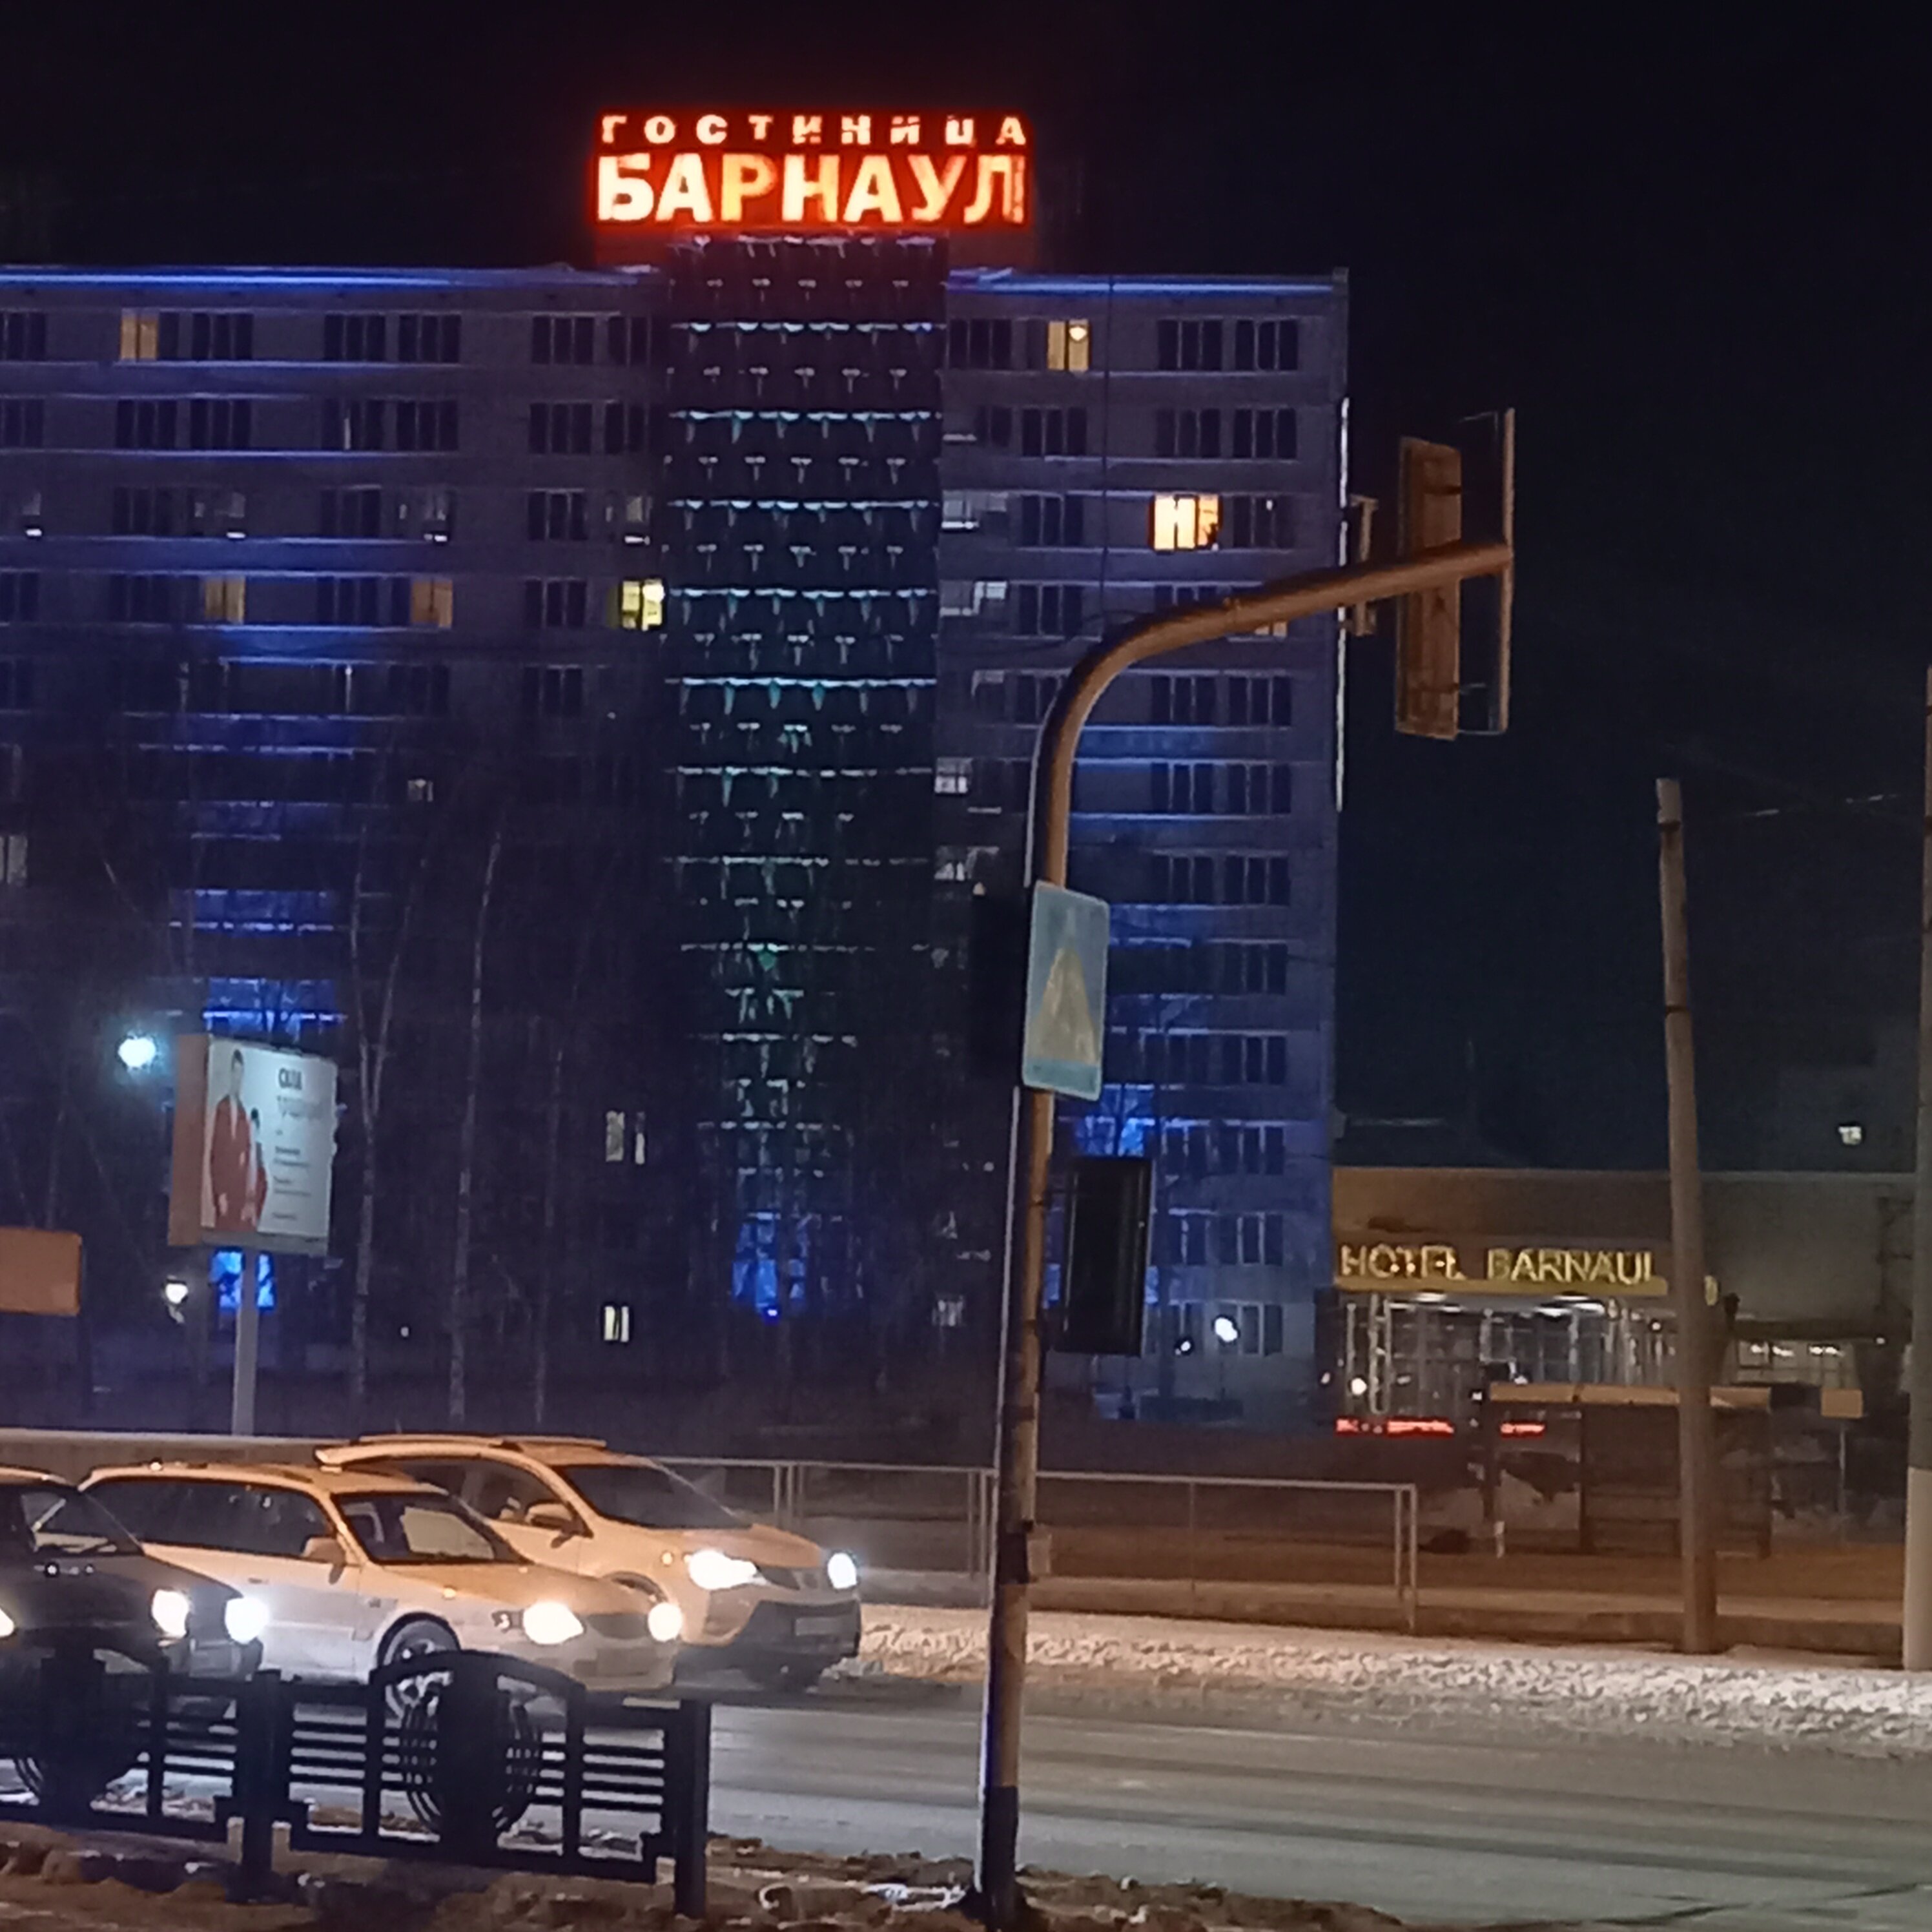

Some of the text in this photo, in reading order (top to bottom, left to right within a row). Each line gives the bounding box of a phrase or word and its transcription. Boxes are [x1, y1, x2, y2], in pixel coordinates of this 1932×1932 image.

[601, 114, 1027, 147] ГОСТИНИЦА
[597, 152, 1025, 223] БАРНАУЛ
[1341, 1243, 1467, 1280] HOTEL
